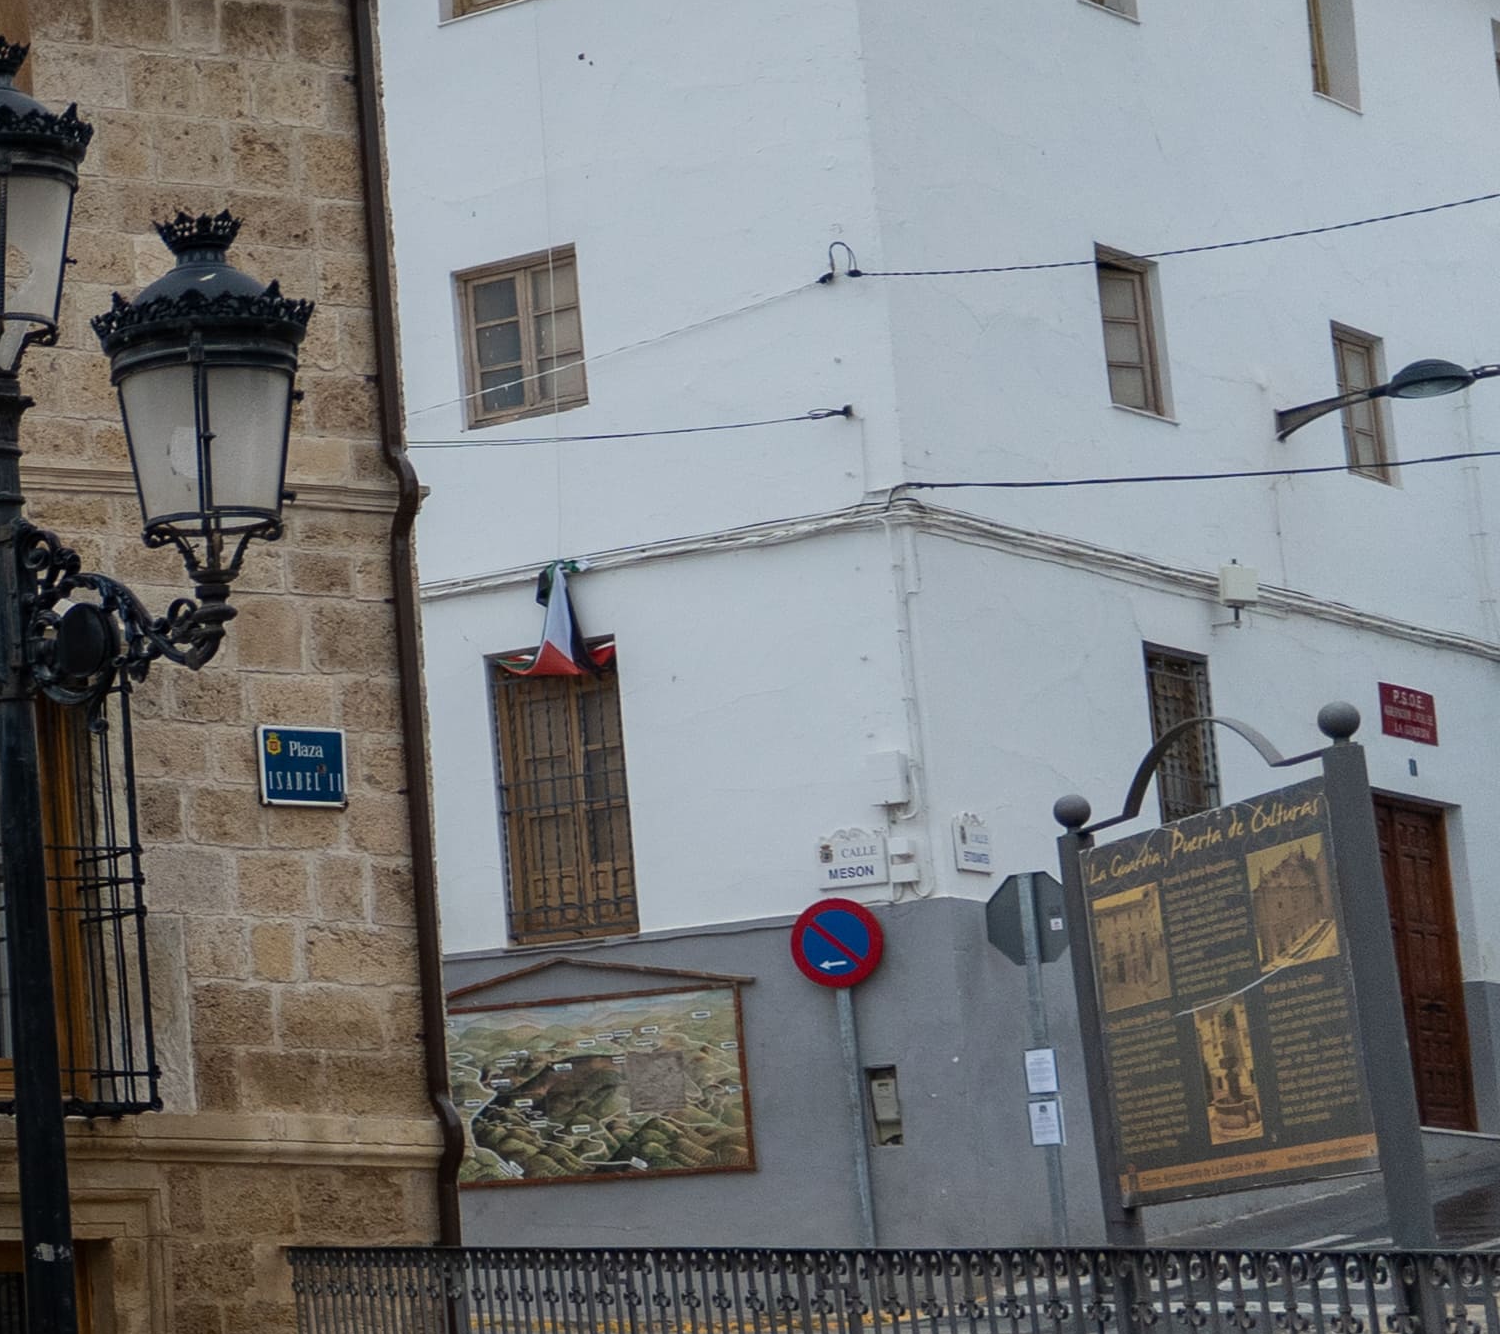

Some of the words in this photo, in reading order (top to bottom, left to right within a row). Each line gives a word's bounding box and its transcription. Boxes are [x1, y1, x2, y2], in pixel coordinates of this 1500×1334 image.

[288, 740, 324, 758] Plaza
[268, 770, 322, 791] ISABEL
[328, 772, 343, 792] II
[1089, 862, 1107, 884] La
[1170, 826, 1223, 861] Puerta
[1228, 809, 1245, 839] de
[1251, 796, 1319, 833] Culturas
[840, 845, 878, 859] CALLE
[828, 864, 875, 880] MESON
